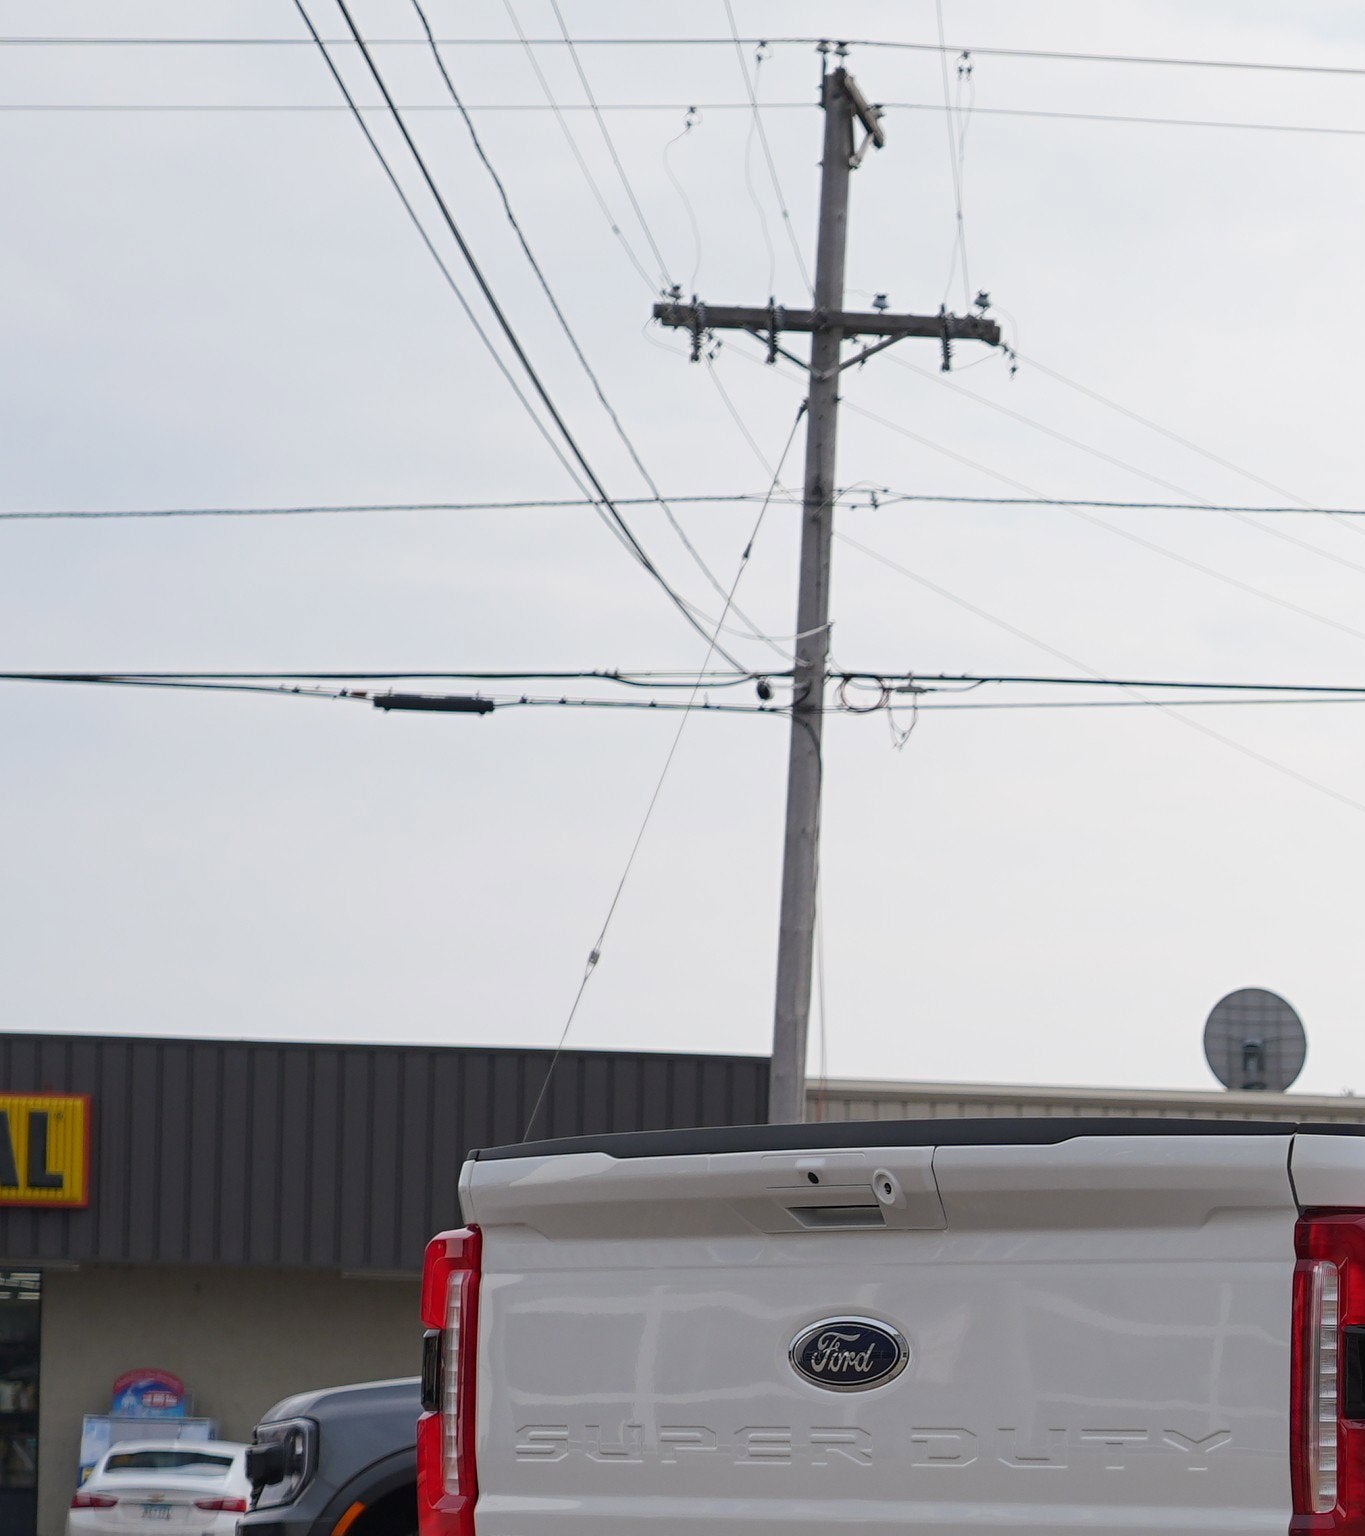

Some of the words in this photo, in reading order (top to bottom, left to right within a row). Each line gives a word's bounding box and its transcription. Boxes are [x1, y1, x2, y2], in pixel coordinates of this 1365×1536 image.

[811, 1332, 875, 1373] Ford
[515, 1424, 873, 1467] SUPER
[911, 1427, 1233, 1471] DUTY
